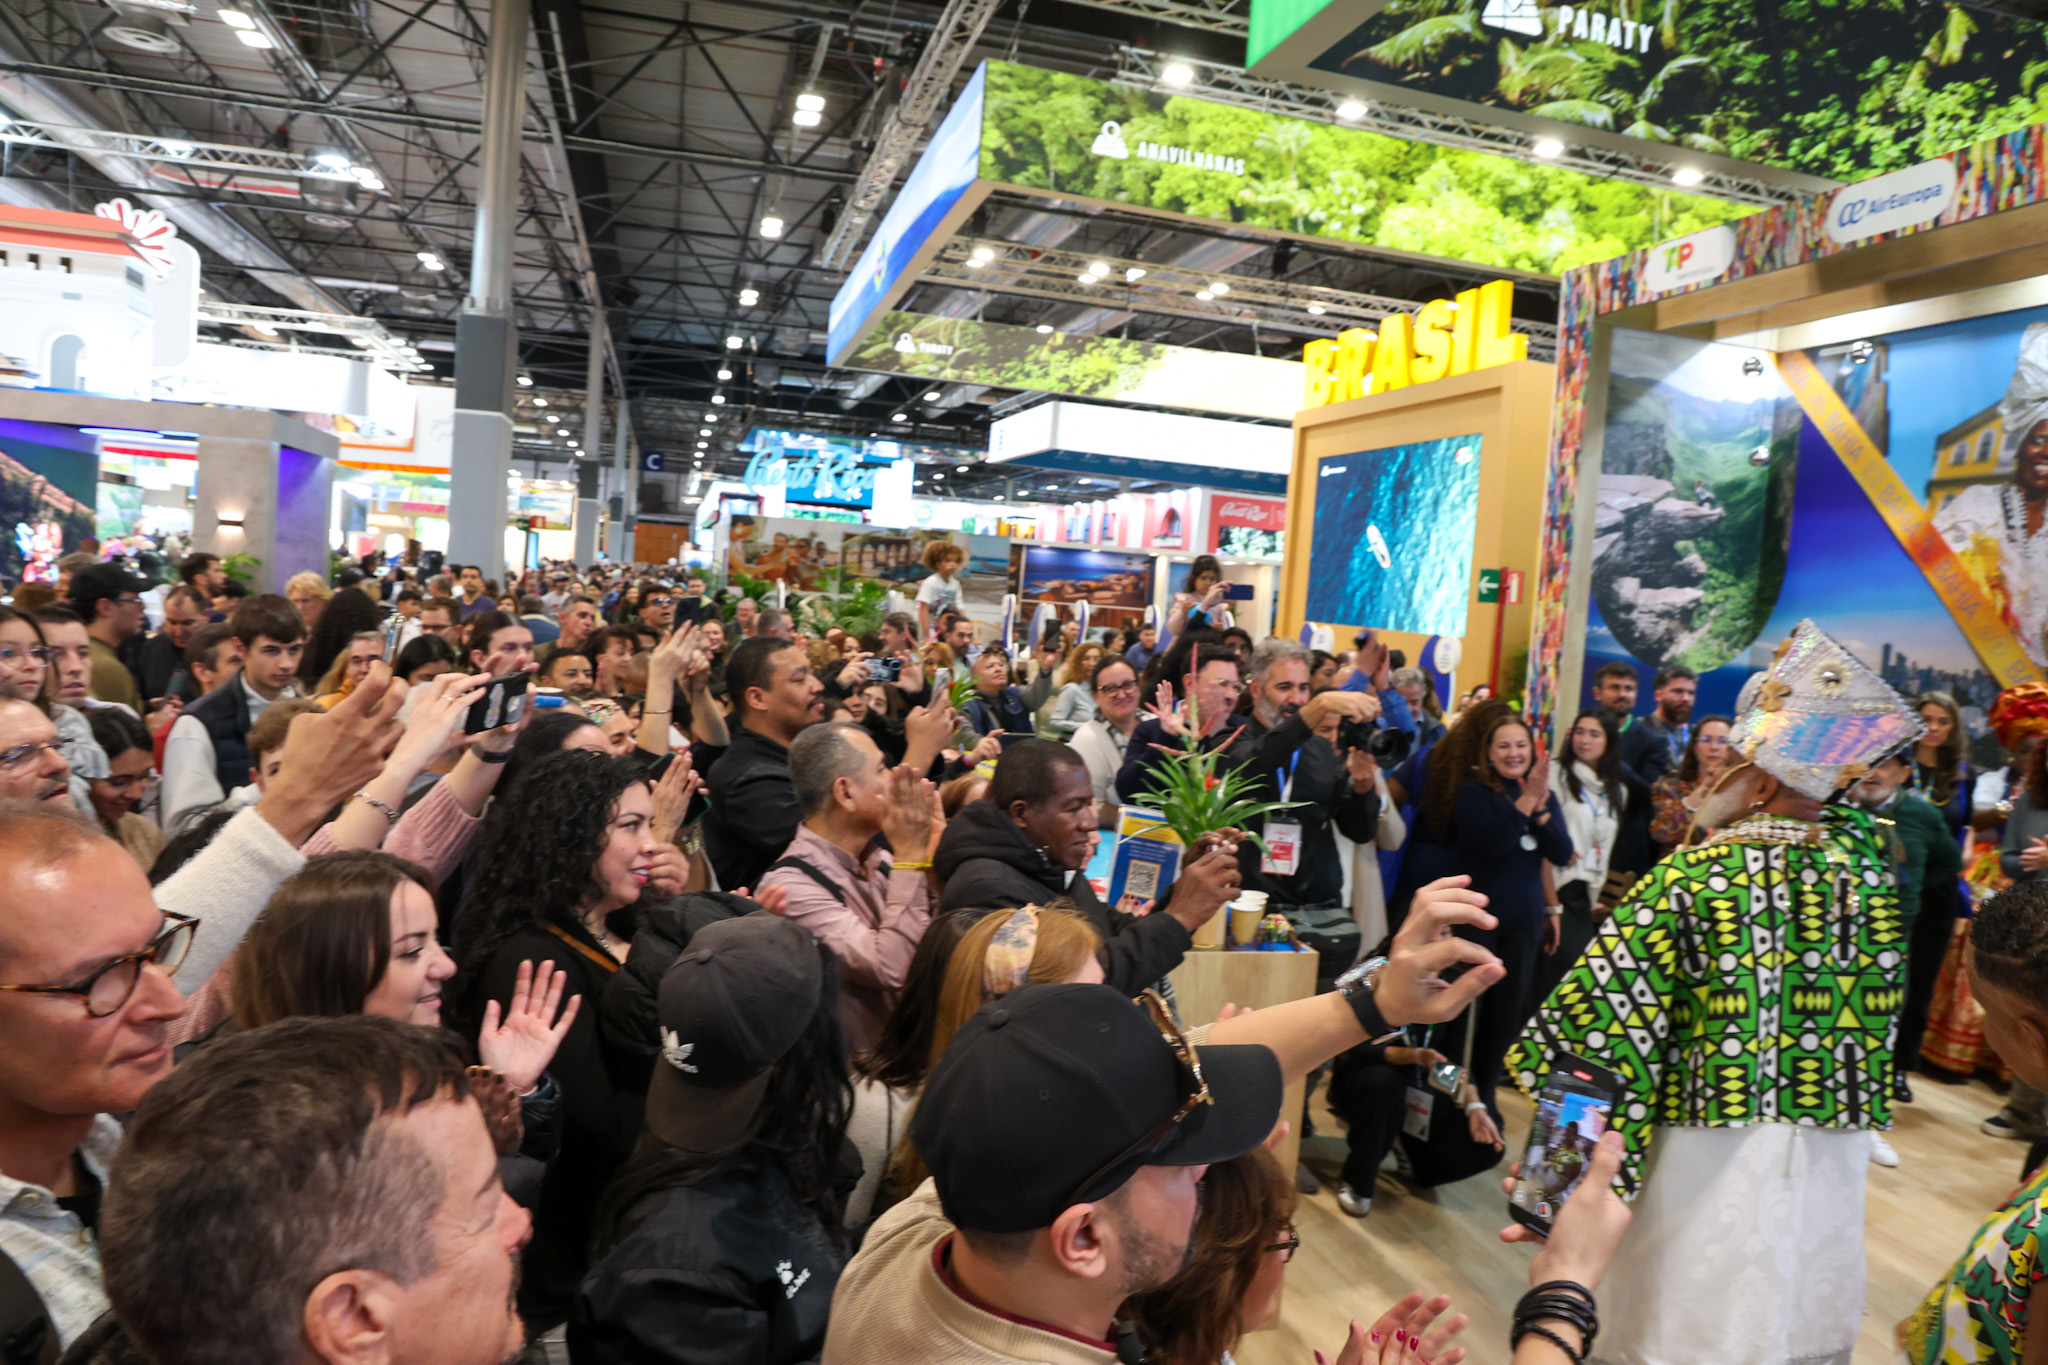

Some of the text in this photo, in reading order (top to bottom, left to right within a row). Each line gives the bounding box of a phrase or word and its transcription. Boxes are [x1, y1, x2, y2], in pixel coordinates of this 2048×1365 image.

[1557, 4, 1654, 54] PARATY
[1136, 141, 1246, 177] ANAVILHANAS
[1662, 242, 1694, 273] TAP
[1302, 279, 1529, 412] BRASIL
[646, 454, 661, 470] C
[1823, 409, 1864, 464] BAHIA
[744, 446, 877, 501] Puerto Rico
[1877, 483, 1922, 540] BAHIA
[1931, 559, 1980, 622] BAHIA
